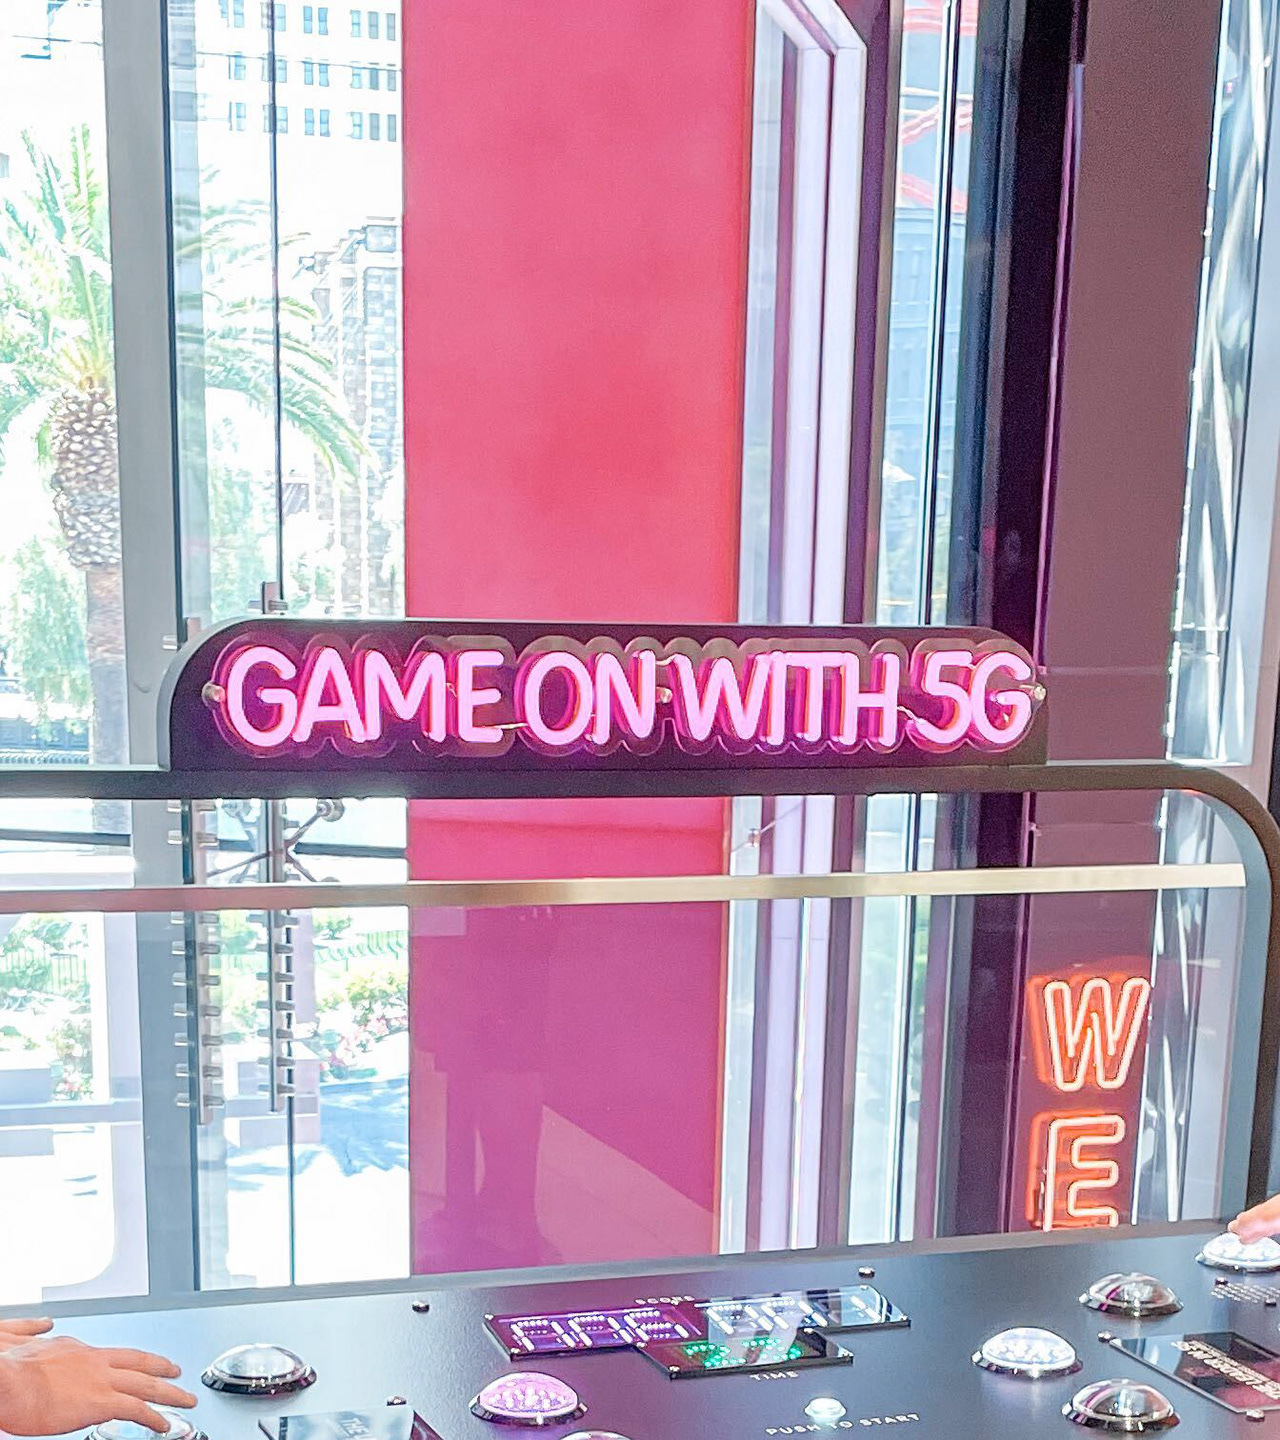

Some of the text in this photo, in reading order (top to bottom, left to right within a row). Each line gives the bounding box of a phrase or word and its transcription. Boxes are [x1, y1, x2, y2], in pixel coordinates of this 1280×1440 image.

[227, 646, 1032, 746] GAME ON WITH 5G
[750, 1371, 799, 1381] TIME
[765, 1413, 920, 1436] PUSH TO START
